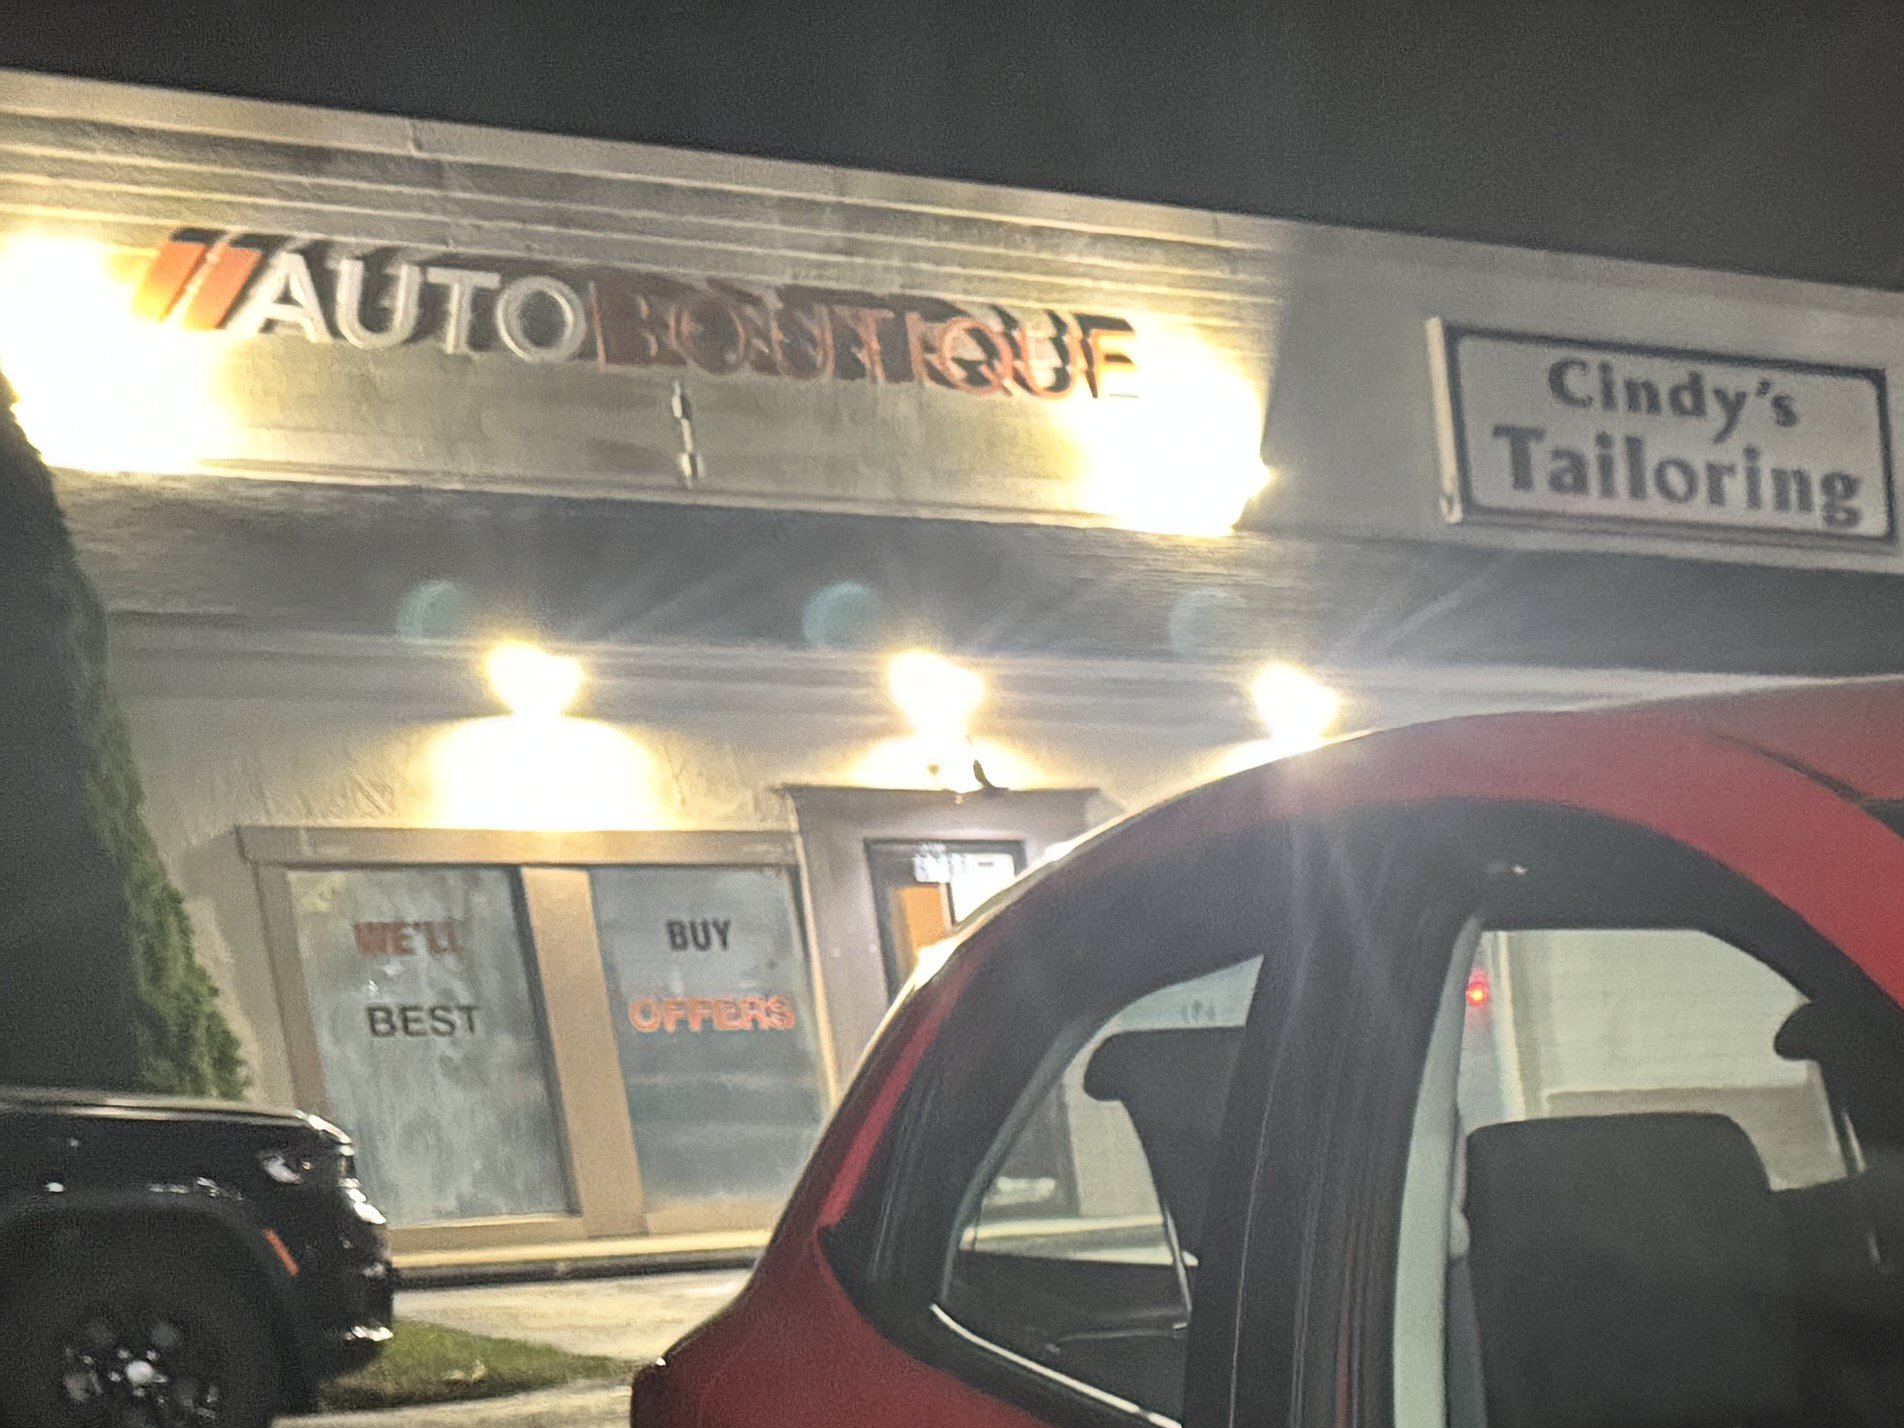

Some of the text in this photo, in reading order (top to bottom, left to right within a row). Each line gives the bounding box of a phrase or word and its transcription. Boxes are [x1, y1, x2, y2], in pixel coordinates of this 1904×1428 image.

[224, 248, 588, 363] AUTO
[1547, 357, 1798, 445] Cindy's
[1491, 424, 1863, 530] Tailoring
[665, 918, 732, 951] BUY
[366, 993, 797, 1038] BEST OFFERS
